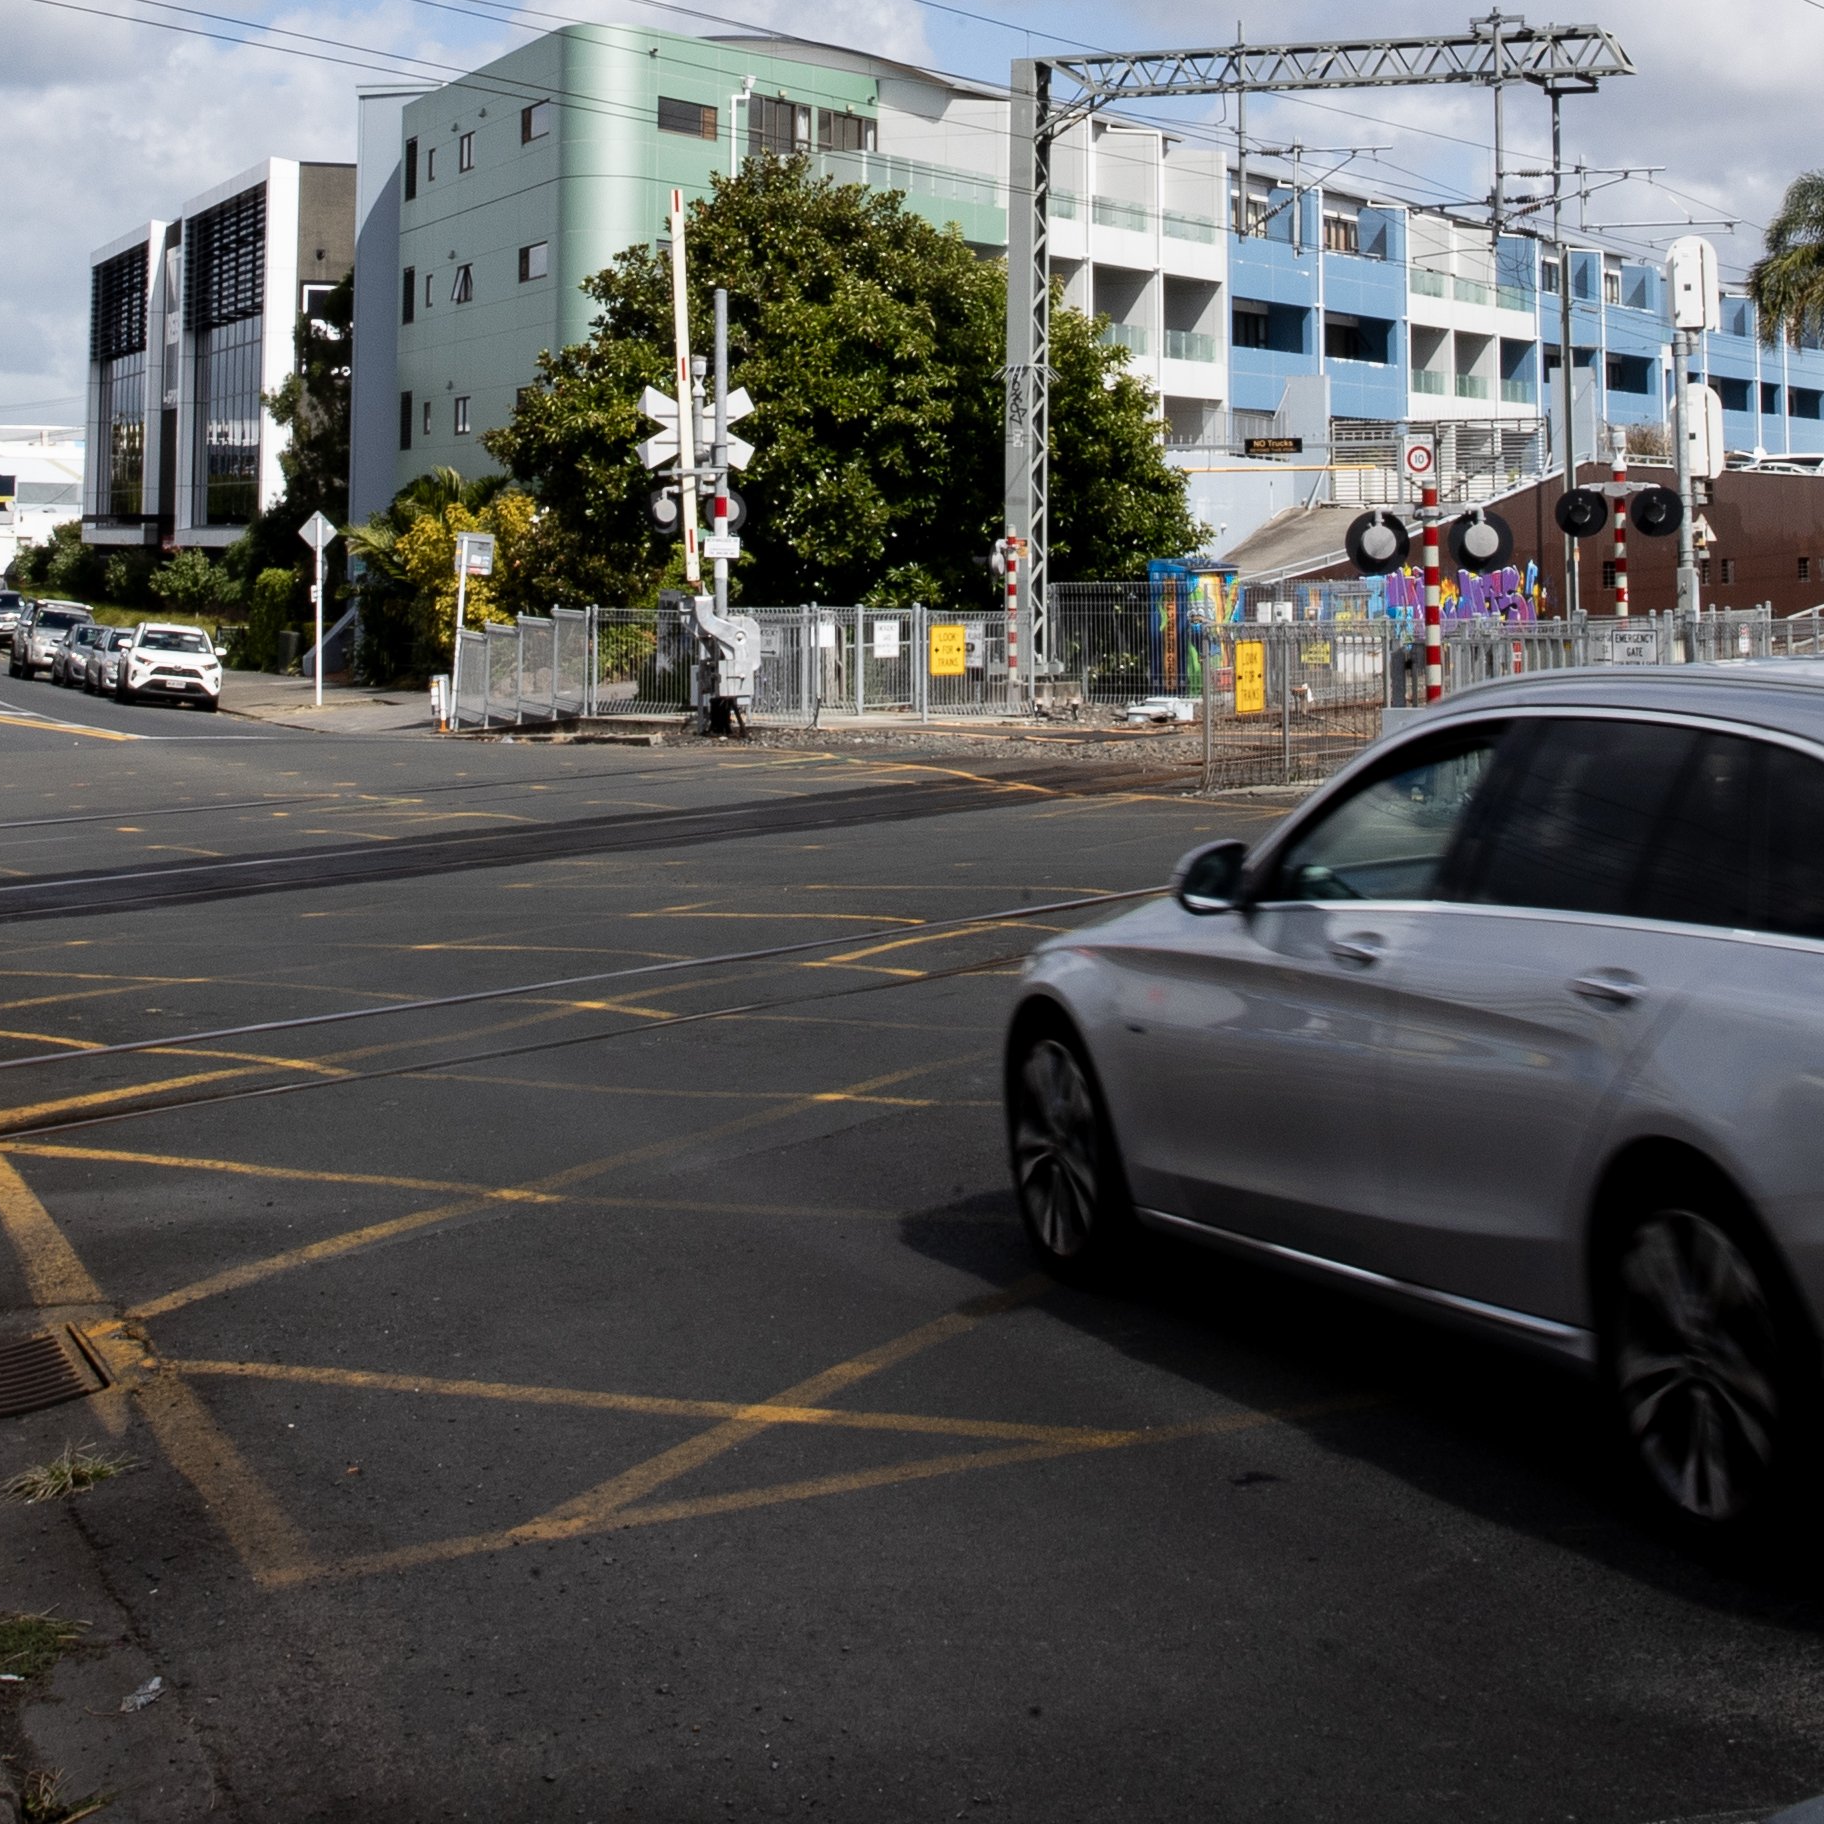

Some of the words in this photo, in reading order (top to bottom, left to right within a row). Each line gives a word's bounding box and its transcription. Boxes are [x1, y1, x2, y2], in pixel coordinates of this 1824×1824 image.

[1414, 454, 1425, 464] 10
[938, 632, 956, 642] LOOK
[1615, 633, 1654, 643] EMERGENCY
[942, 645, 953, 655] FOR
[1627, 647, 1644, 658] GATE
